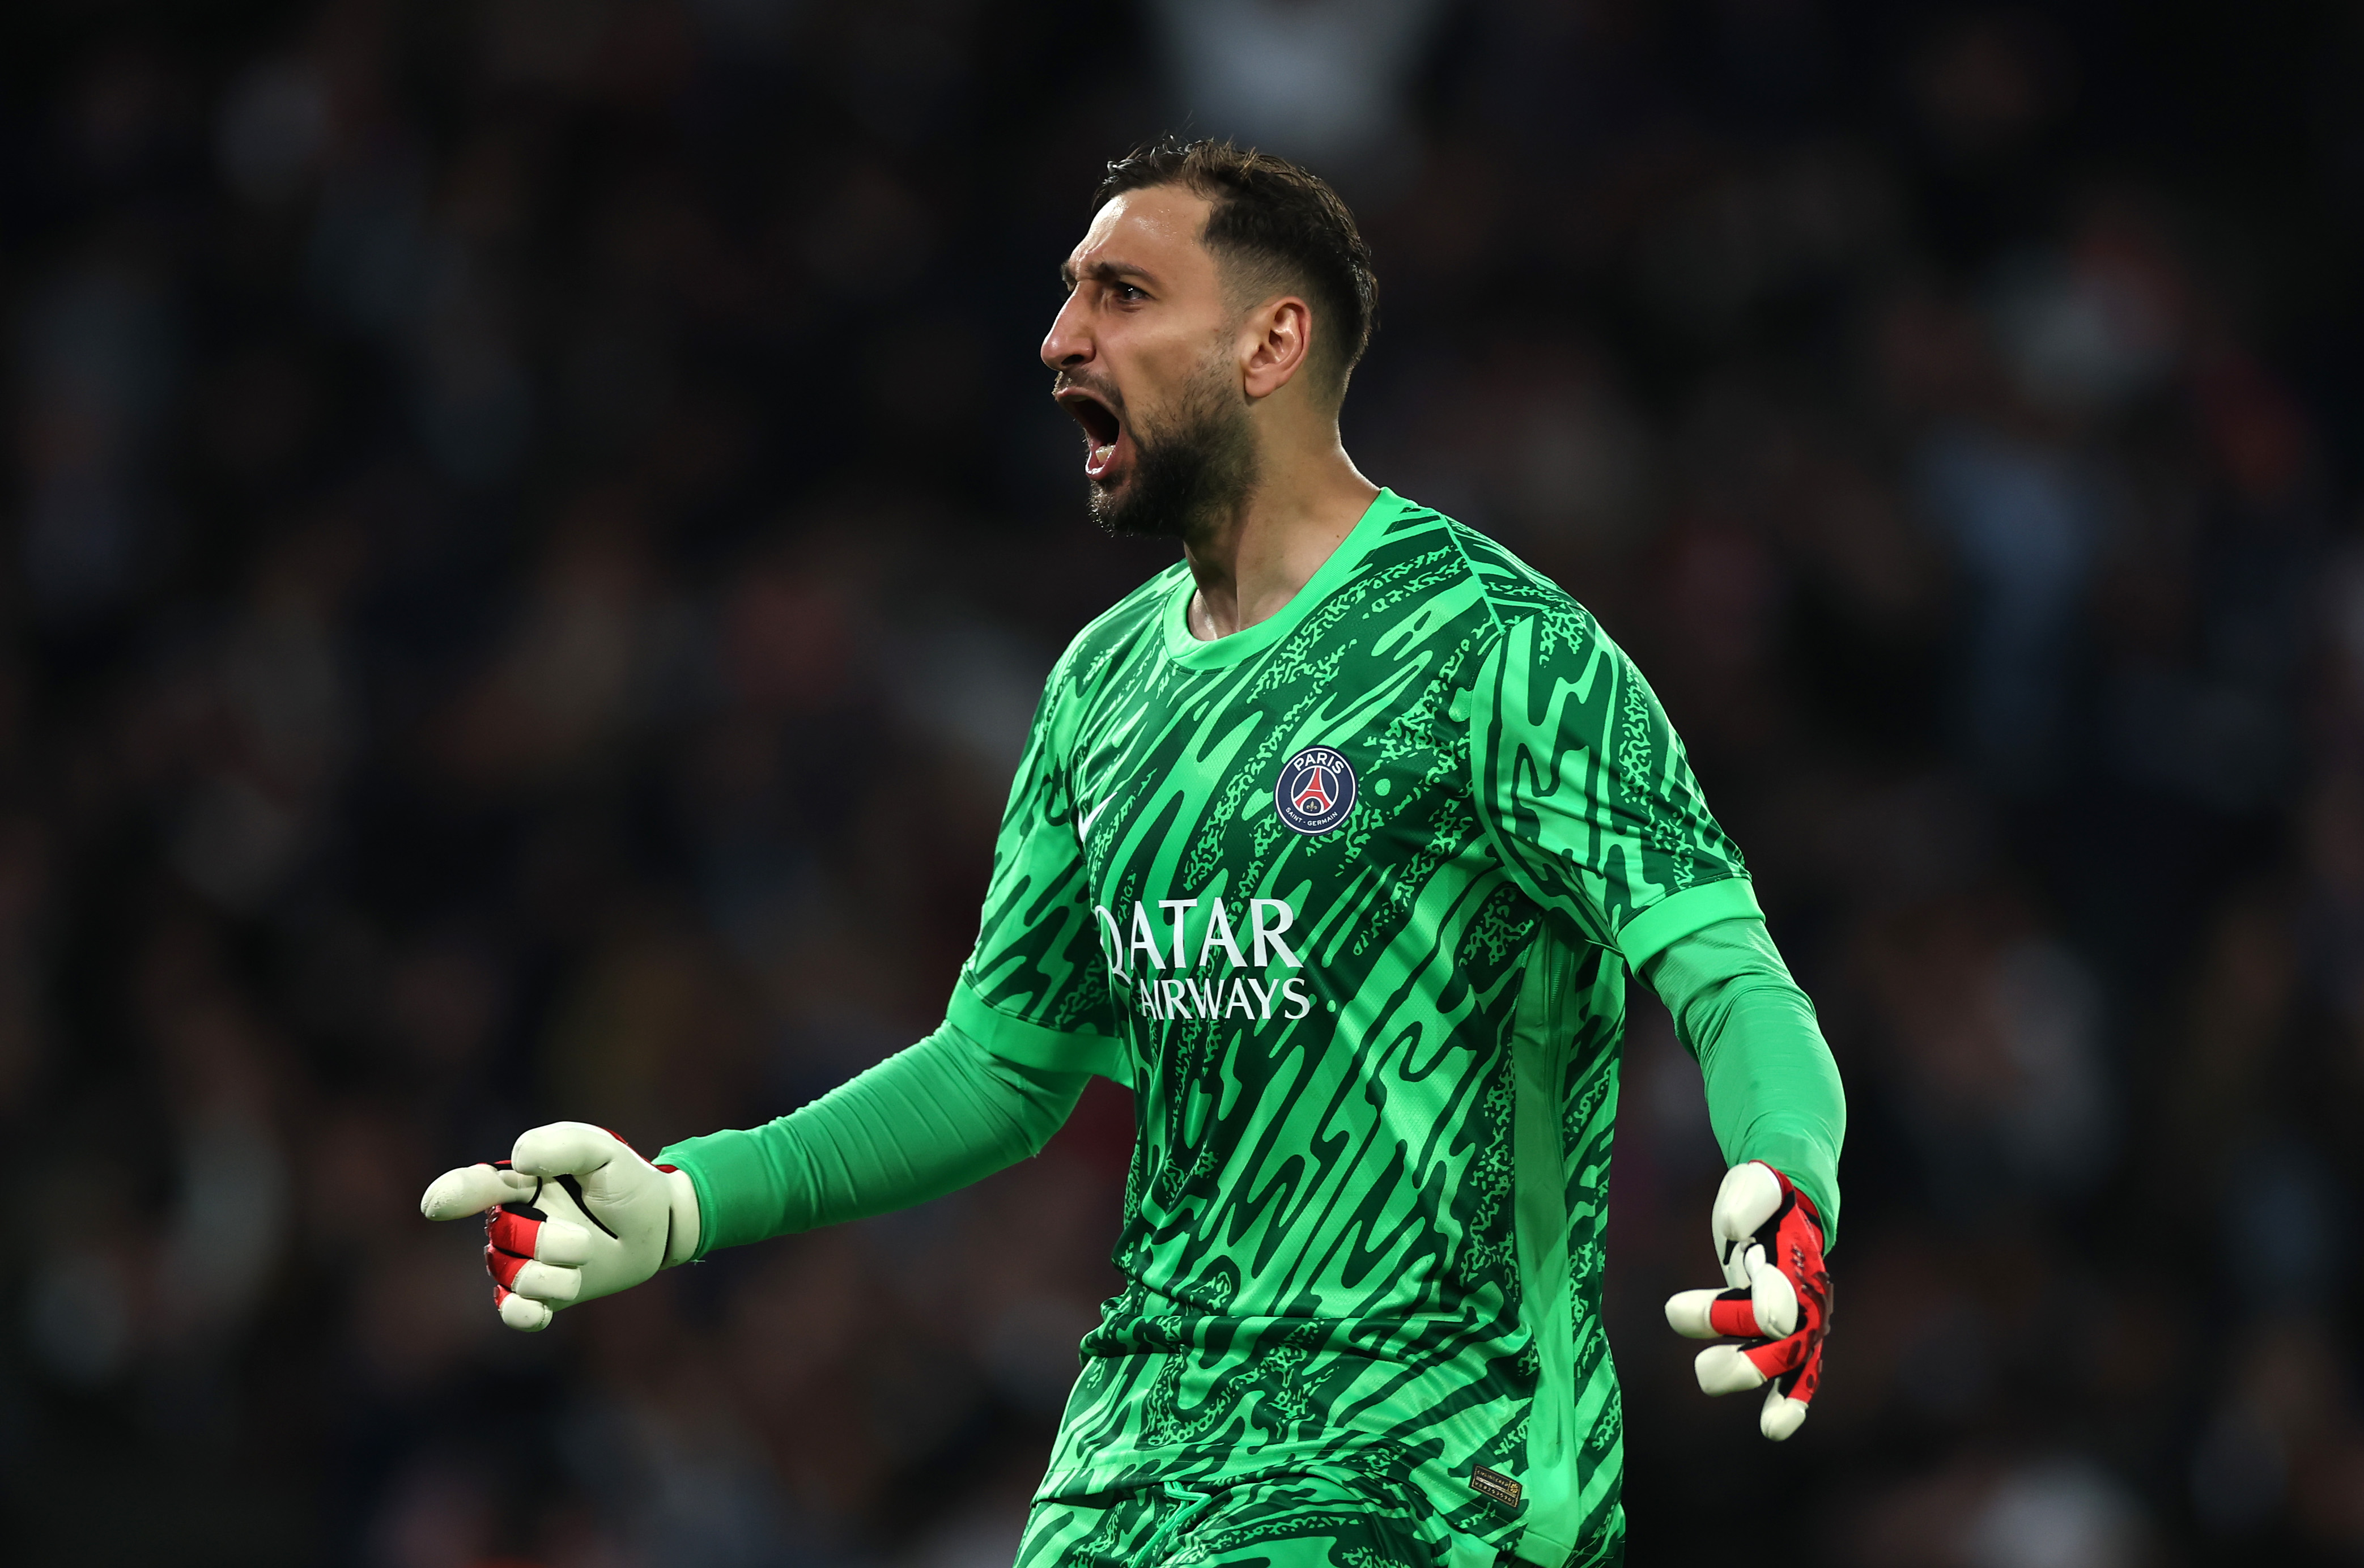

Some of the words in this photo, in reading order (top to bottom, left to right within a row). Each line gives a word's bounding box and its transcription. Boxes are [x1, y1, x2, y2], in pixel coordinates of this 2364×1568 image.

[1293, 752, 1344, 774] PARIS
[1285, 807, 1303, 823] SAINT
[1307, 811, 1338, 826] GERMAIN
[1094, 897, 1304, 985] QATAR
[1140, 978, 1310, 1020] AIRWAYS
